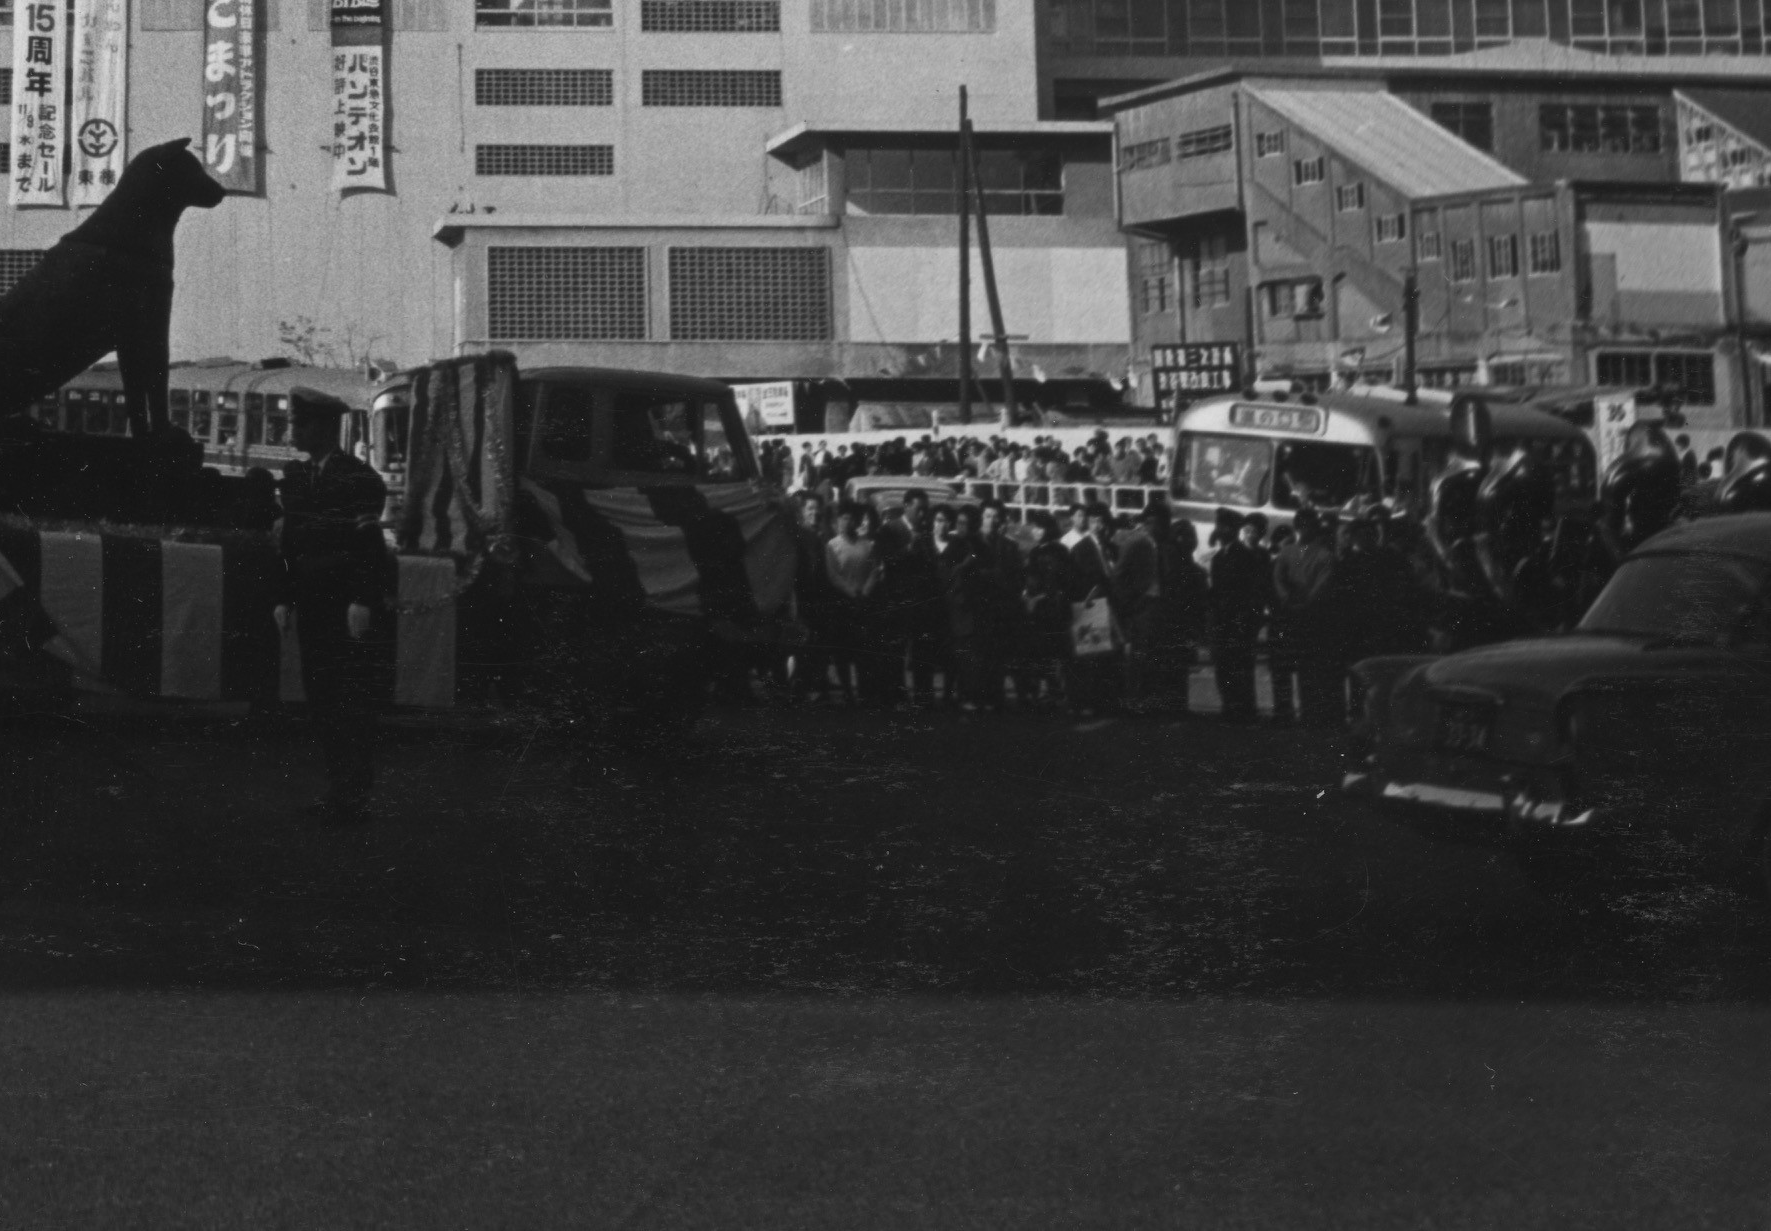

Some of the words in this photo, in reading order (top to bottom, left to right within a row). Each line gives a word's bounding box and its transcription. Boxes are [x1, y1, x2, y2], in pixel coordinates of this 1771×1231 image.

[25, 3, 56, 97] 15周年
[38, 104, 57, 193] 記念セール
